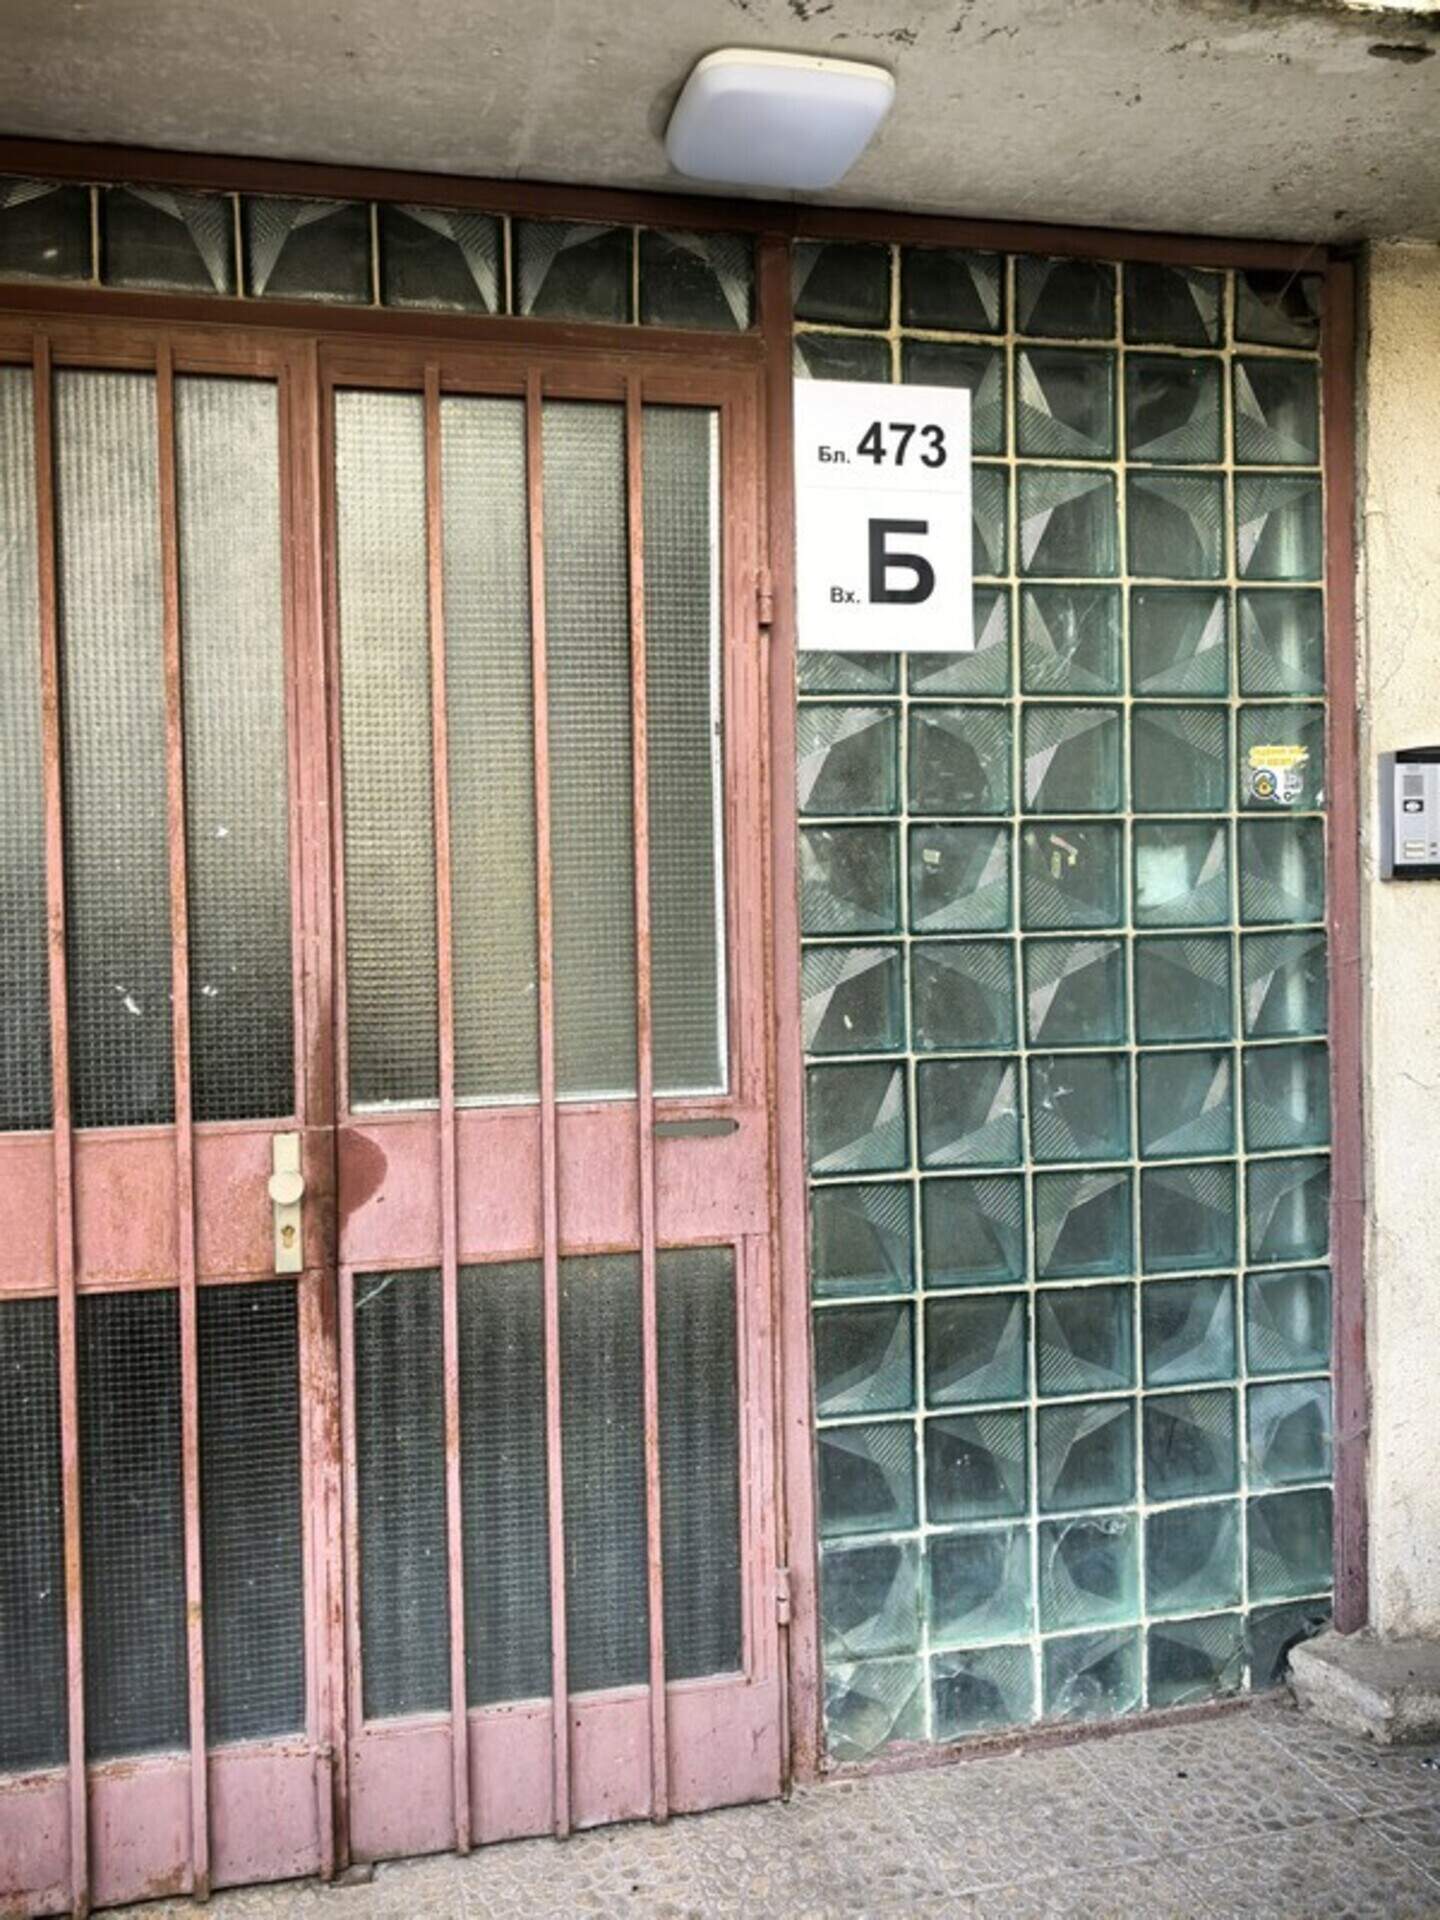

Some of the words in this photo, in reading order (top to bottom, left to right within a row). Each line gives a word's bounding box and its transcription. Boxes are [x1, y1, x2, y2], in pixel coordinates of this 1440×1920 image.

[818, 446, 850, 464] Бл.
[857, 421, 947, 469] 473
[830, 587, 860, 604] Вх.
[868, 518, 936, 605] Б
